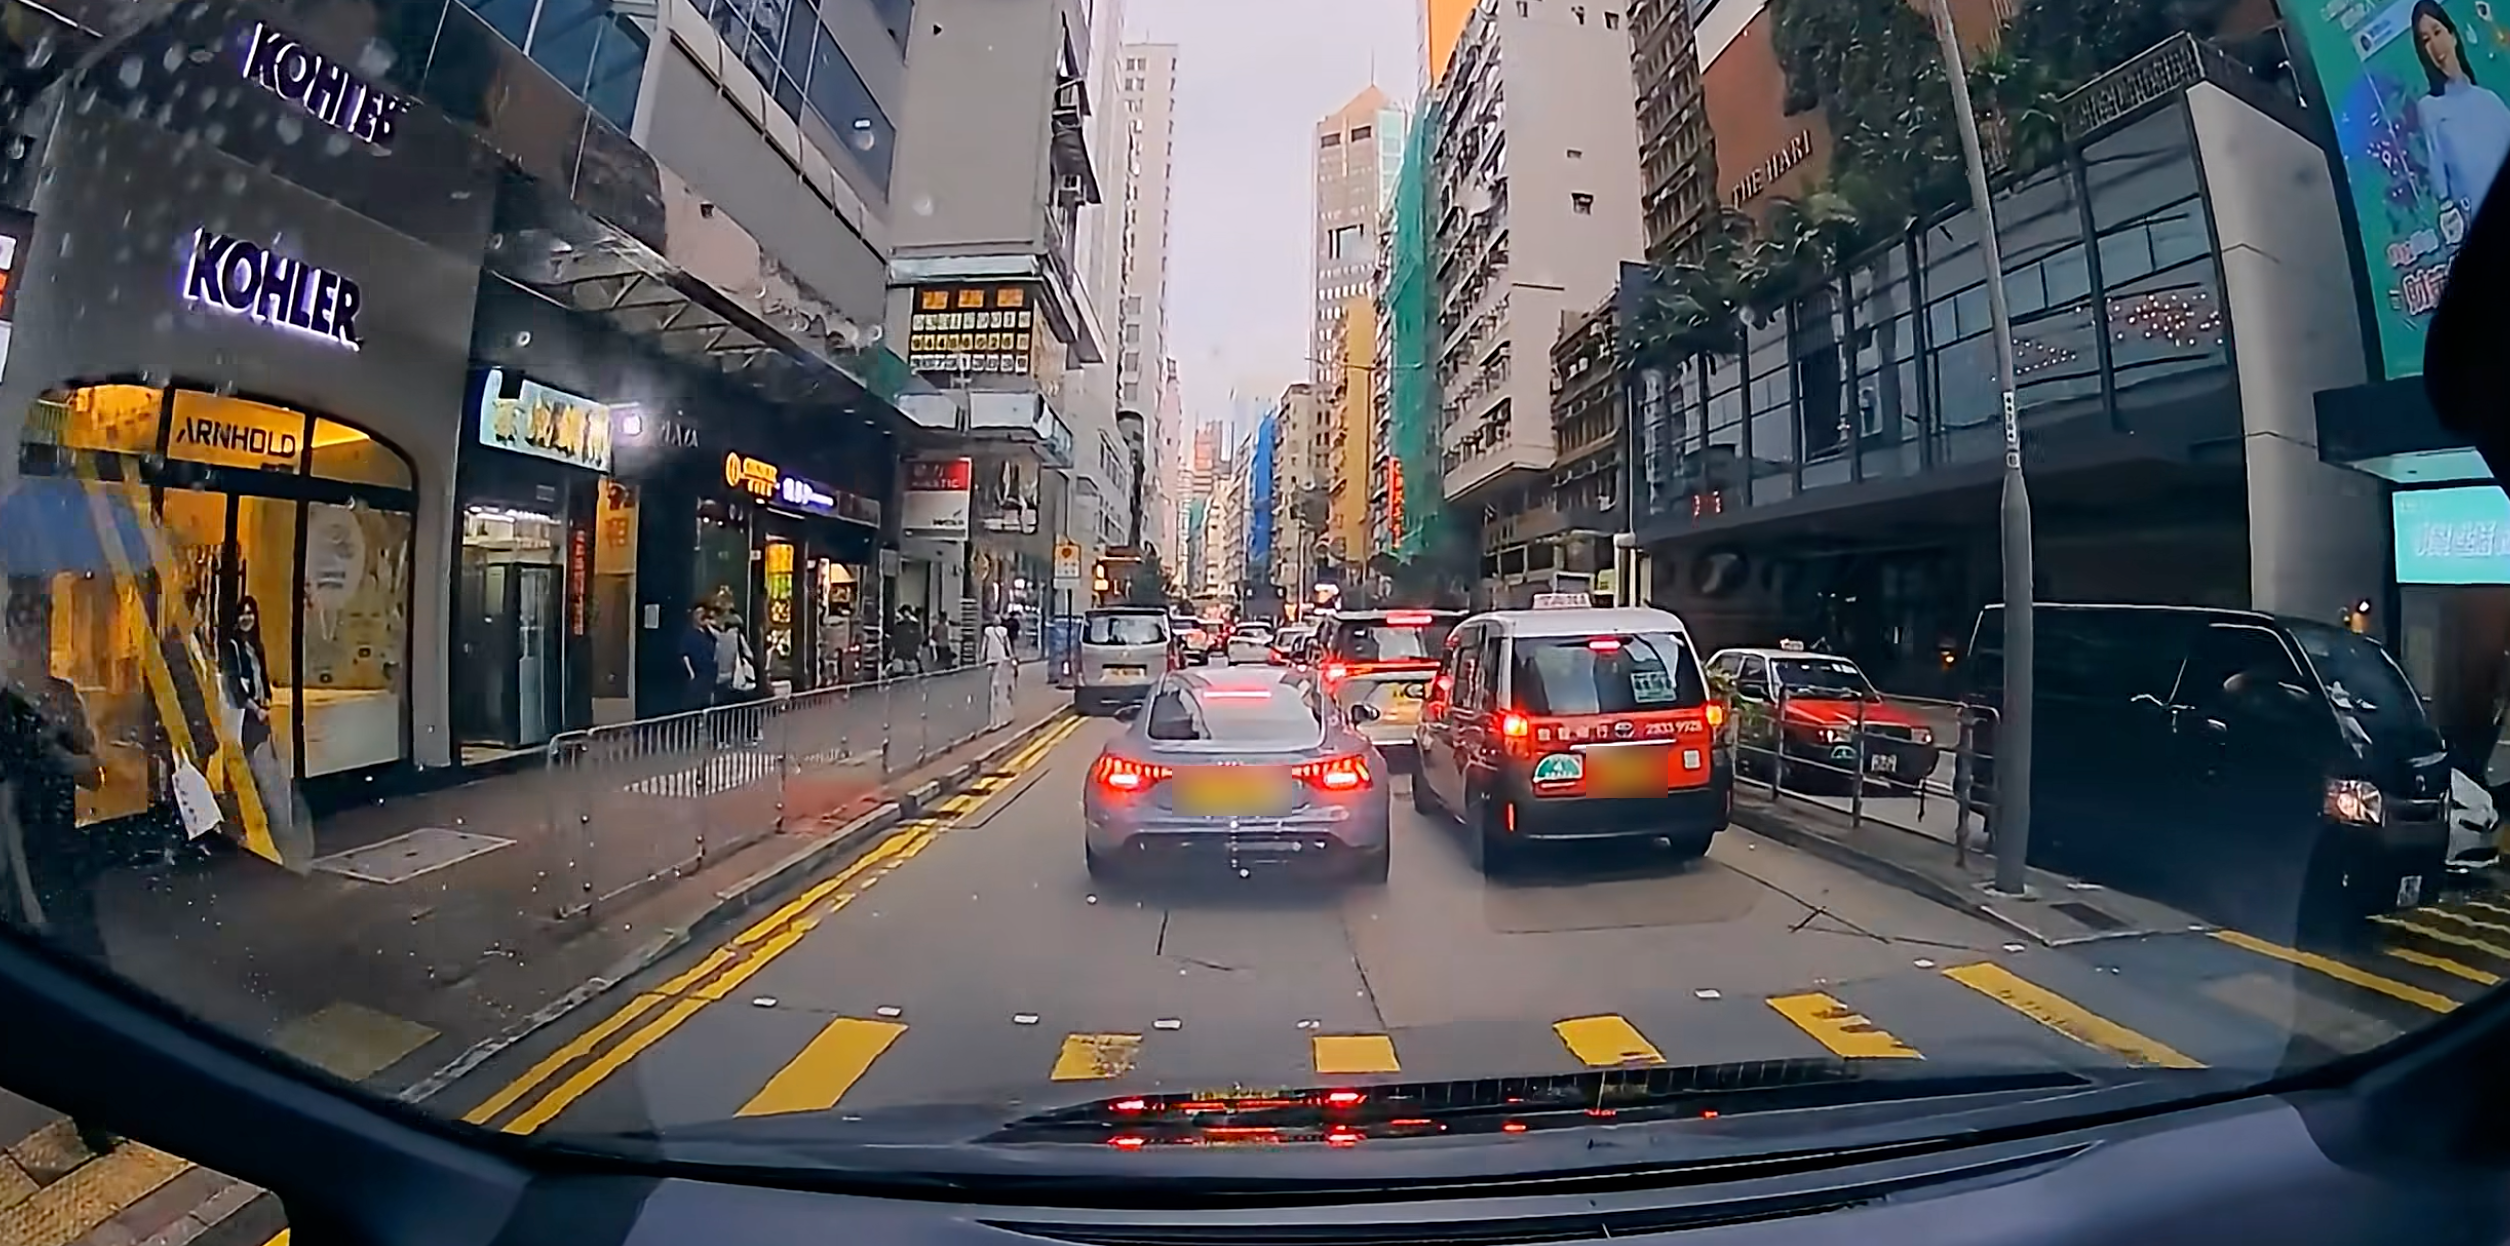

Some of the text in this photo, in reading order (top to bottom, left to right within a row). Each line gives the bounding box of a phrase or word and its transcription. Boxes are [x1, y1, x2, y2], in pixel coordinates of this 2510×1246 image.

[1732, 129, 1811, 211] THE HARI
[182, 226, 363, 352] KOHLER
[176, 416, 296, 458] ARNHOLD
